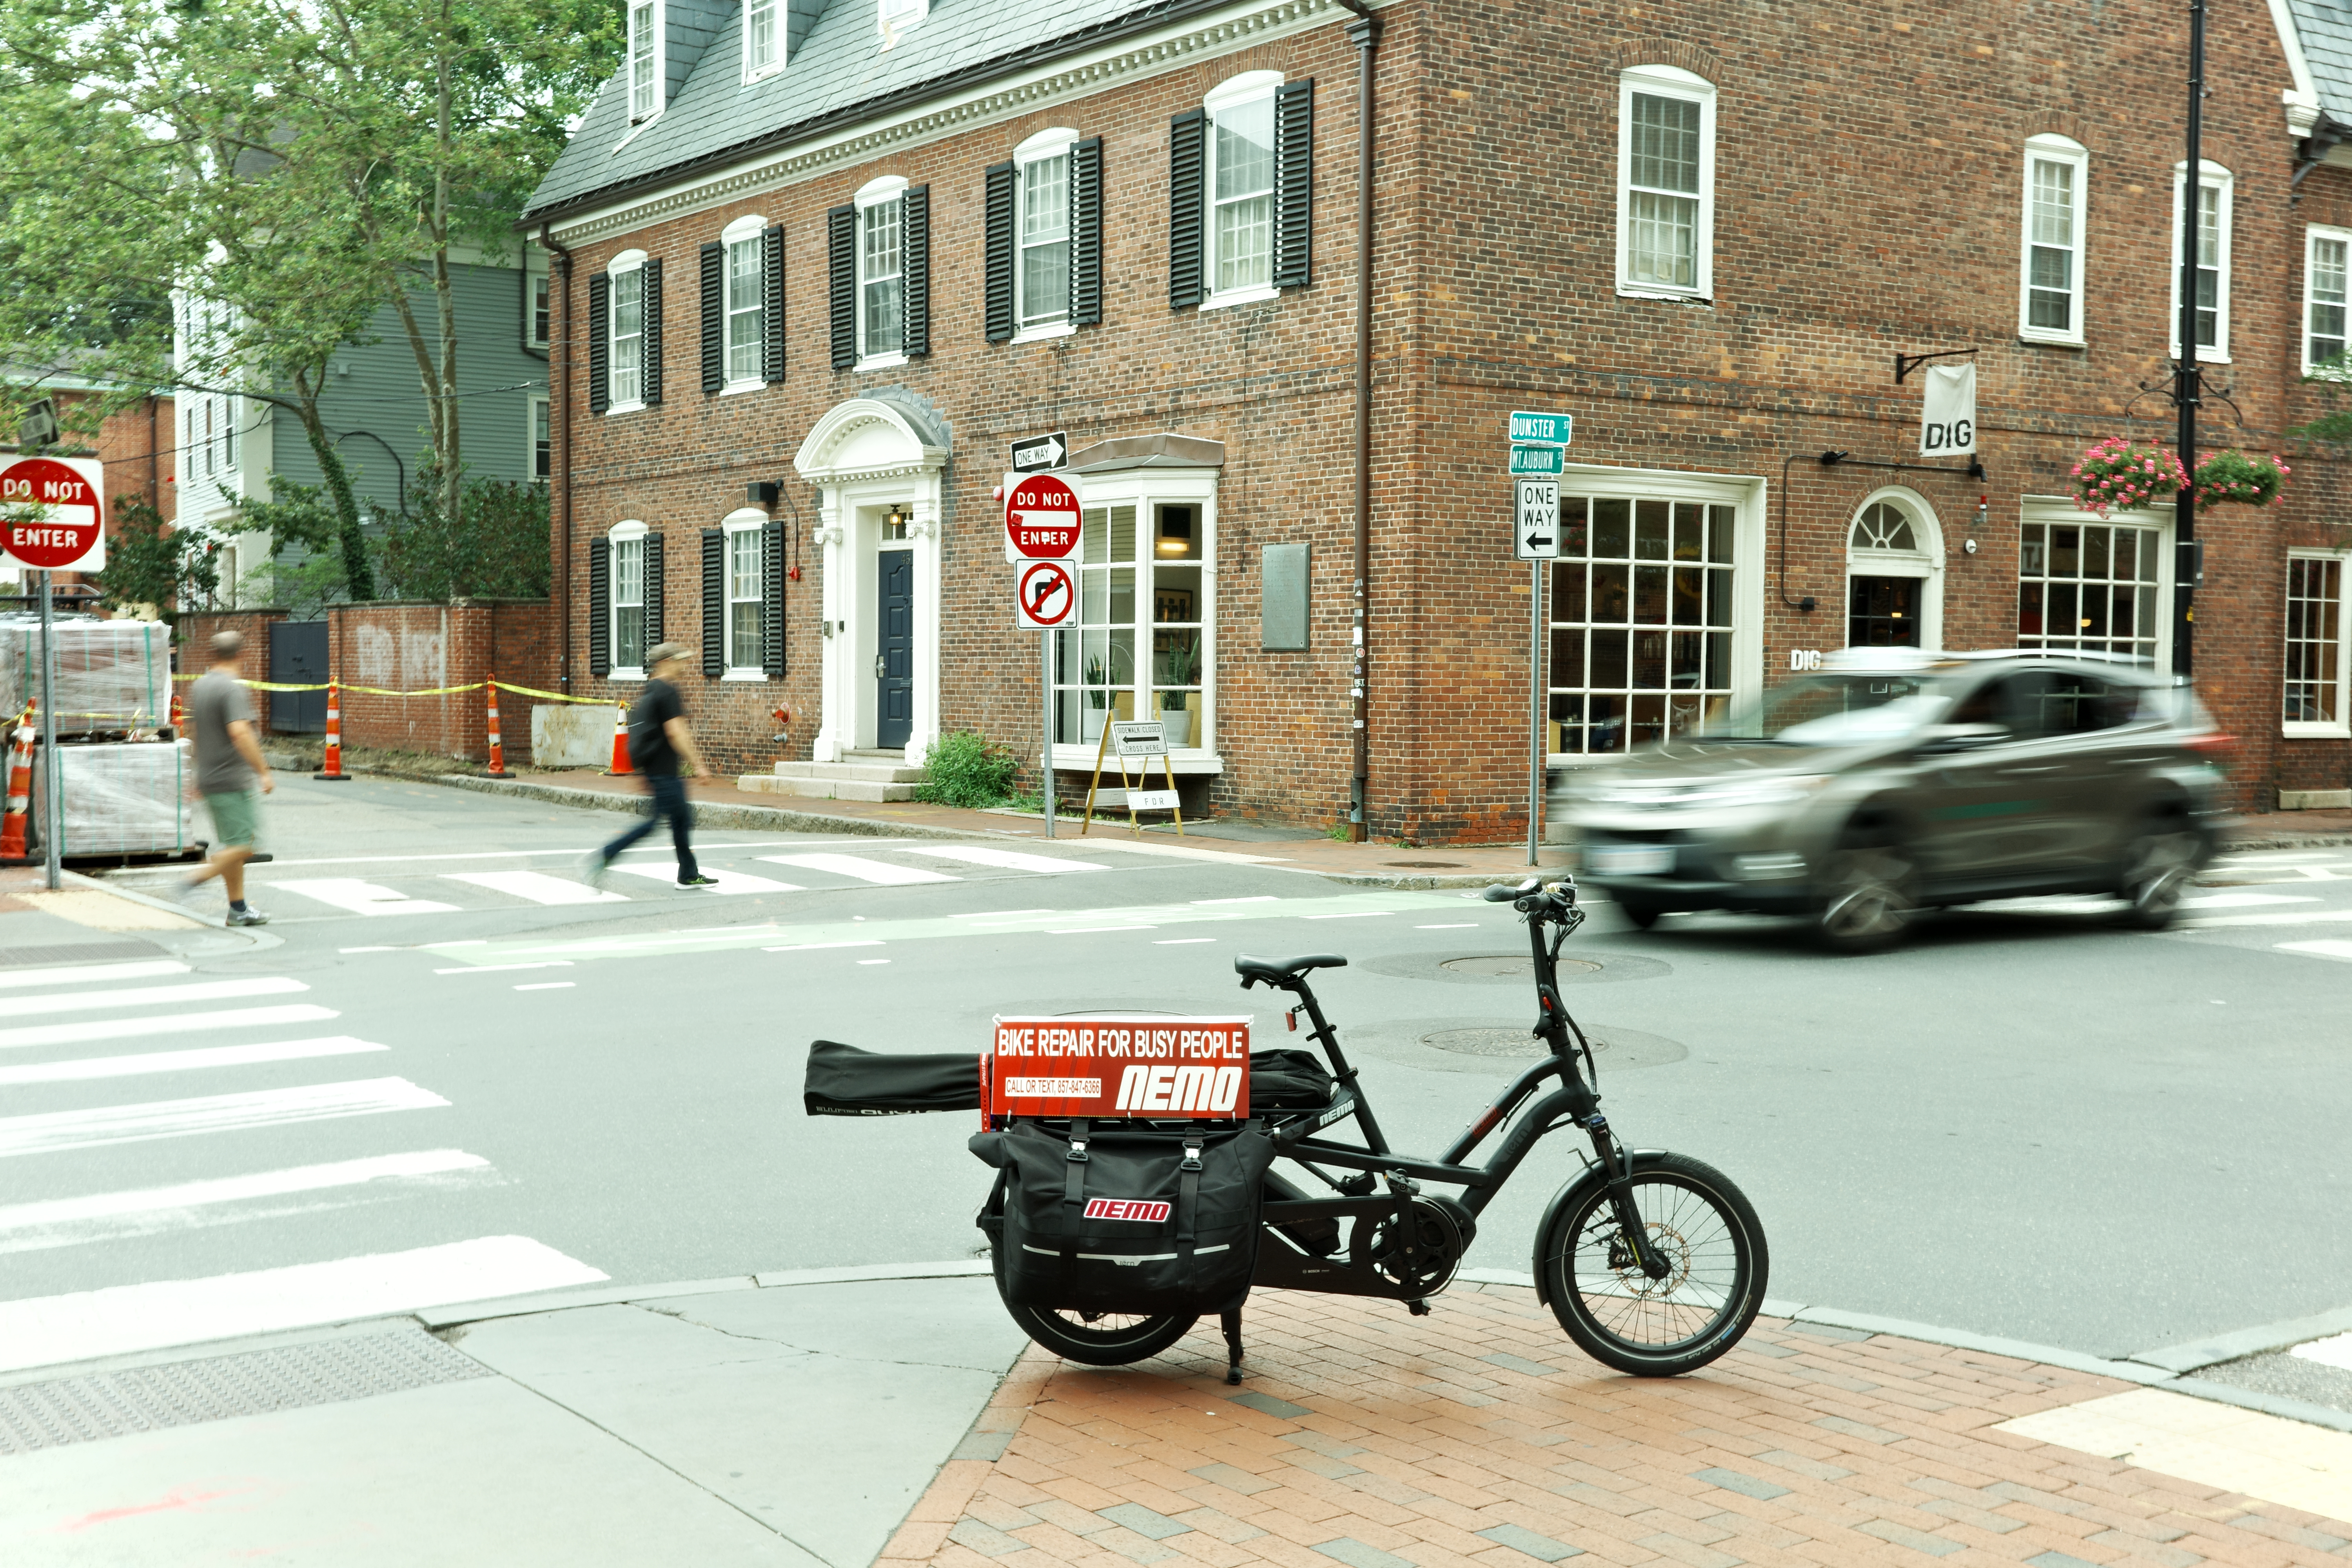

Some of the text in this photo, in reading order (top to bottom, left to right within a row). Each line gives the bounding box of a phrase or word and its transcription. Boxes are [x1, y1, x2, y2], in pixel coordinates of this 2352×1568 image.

[1512, 417, 1570, 438] DUNSTER ST
[1926, 419, 1971, 449] DIG
[1017, 446, 1049, 465] ONE WAY
[1558, 452, 1563, 460] ST
[3, 478, 84, 500] DO NOT
[1017, 492, 1070, 506] DO NOT
[1525, 487, 1554, 504] ONE
[1524, 509, 1555, 526] WAY
[13, 528, 78, 548] ENTER
[1021, 531, 1069, 545] ENER
[901, 554, 911, 564] 45
[1791, 649, 1821, 671] DIG
[998, 1029, 1243, 1058] BIKE REPAIR FOR BUSY PEOPLE
[1006, 1079, 1100, 1096] CALL OR TEXT, 857-847-6366
[1115, 1065, 1243, 1111] NEMO
[1319, 1099, 1355, 1127] NEMO
[1085, 1200, 1169, 1221] NEMO
